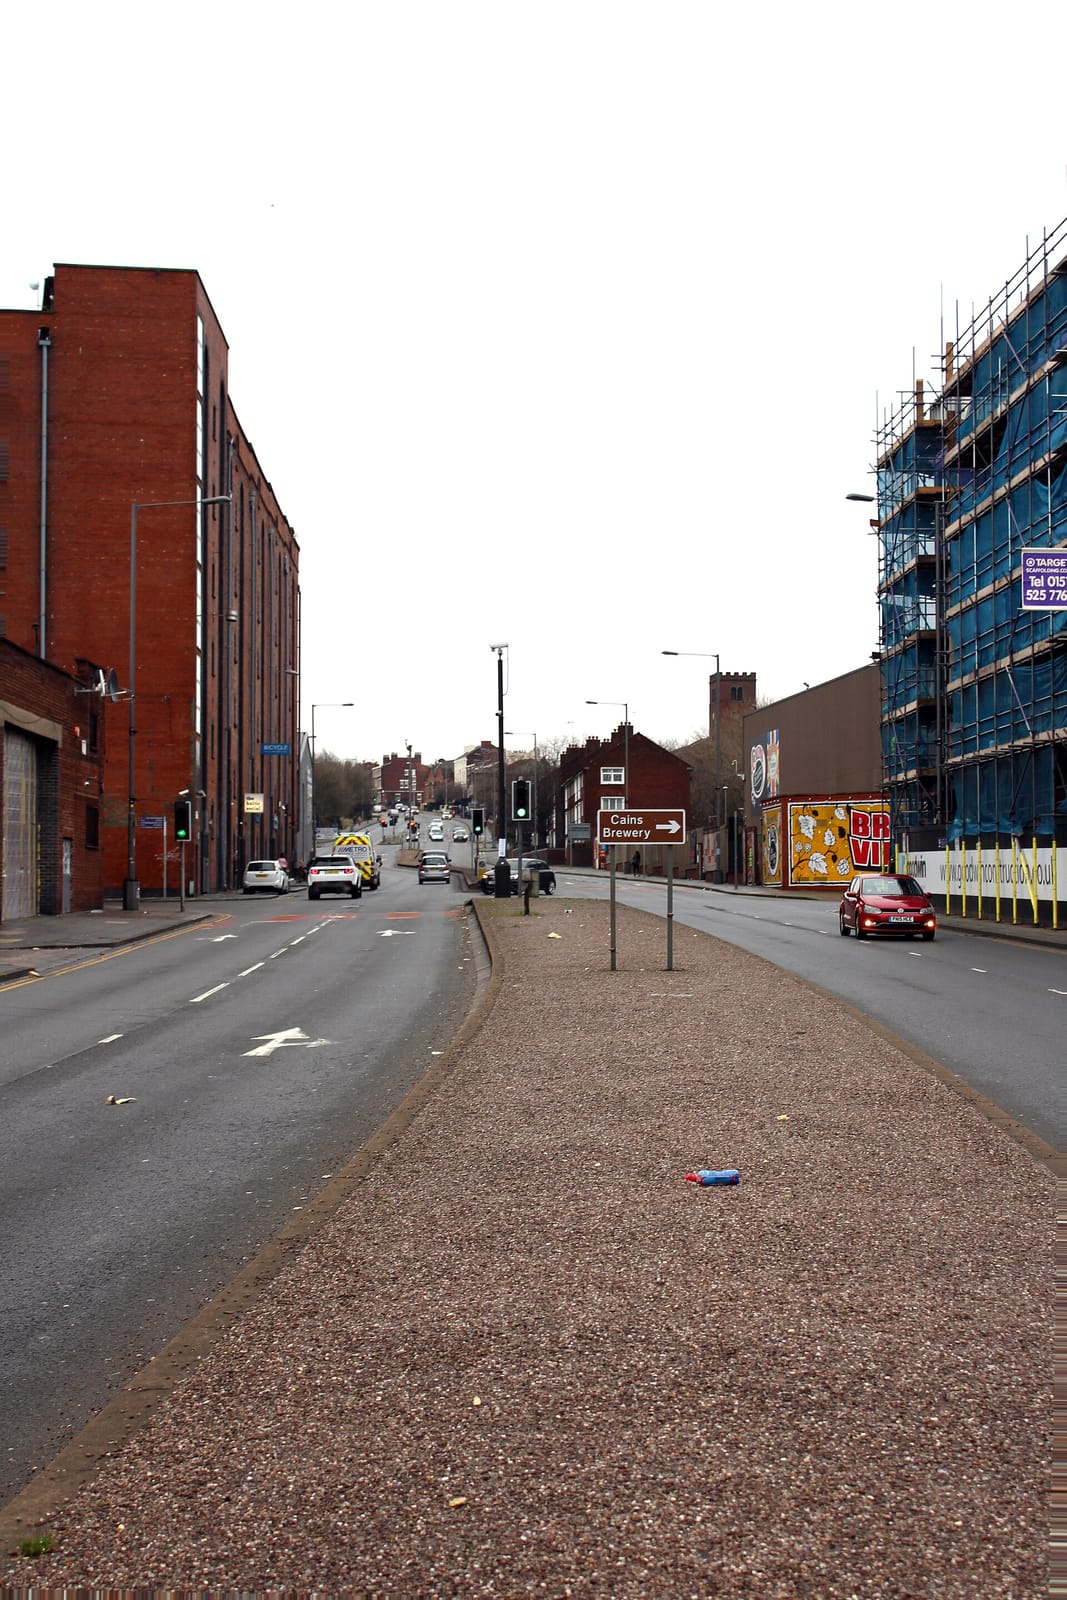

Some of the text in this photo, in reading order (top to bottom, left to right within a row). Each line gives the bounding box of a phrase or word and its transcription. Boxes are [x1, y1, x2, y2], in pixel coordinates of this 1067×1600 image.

[1036, 558, 1067, 566] TARGE
[1029, 575, 1067, 587] Tel 015
[1026, 590, 1067, 601] 525 776
[611, 814, 643, 825] Cains
[603, 828, 651, 839] Brewery
